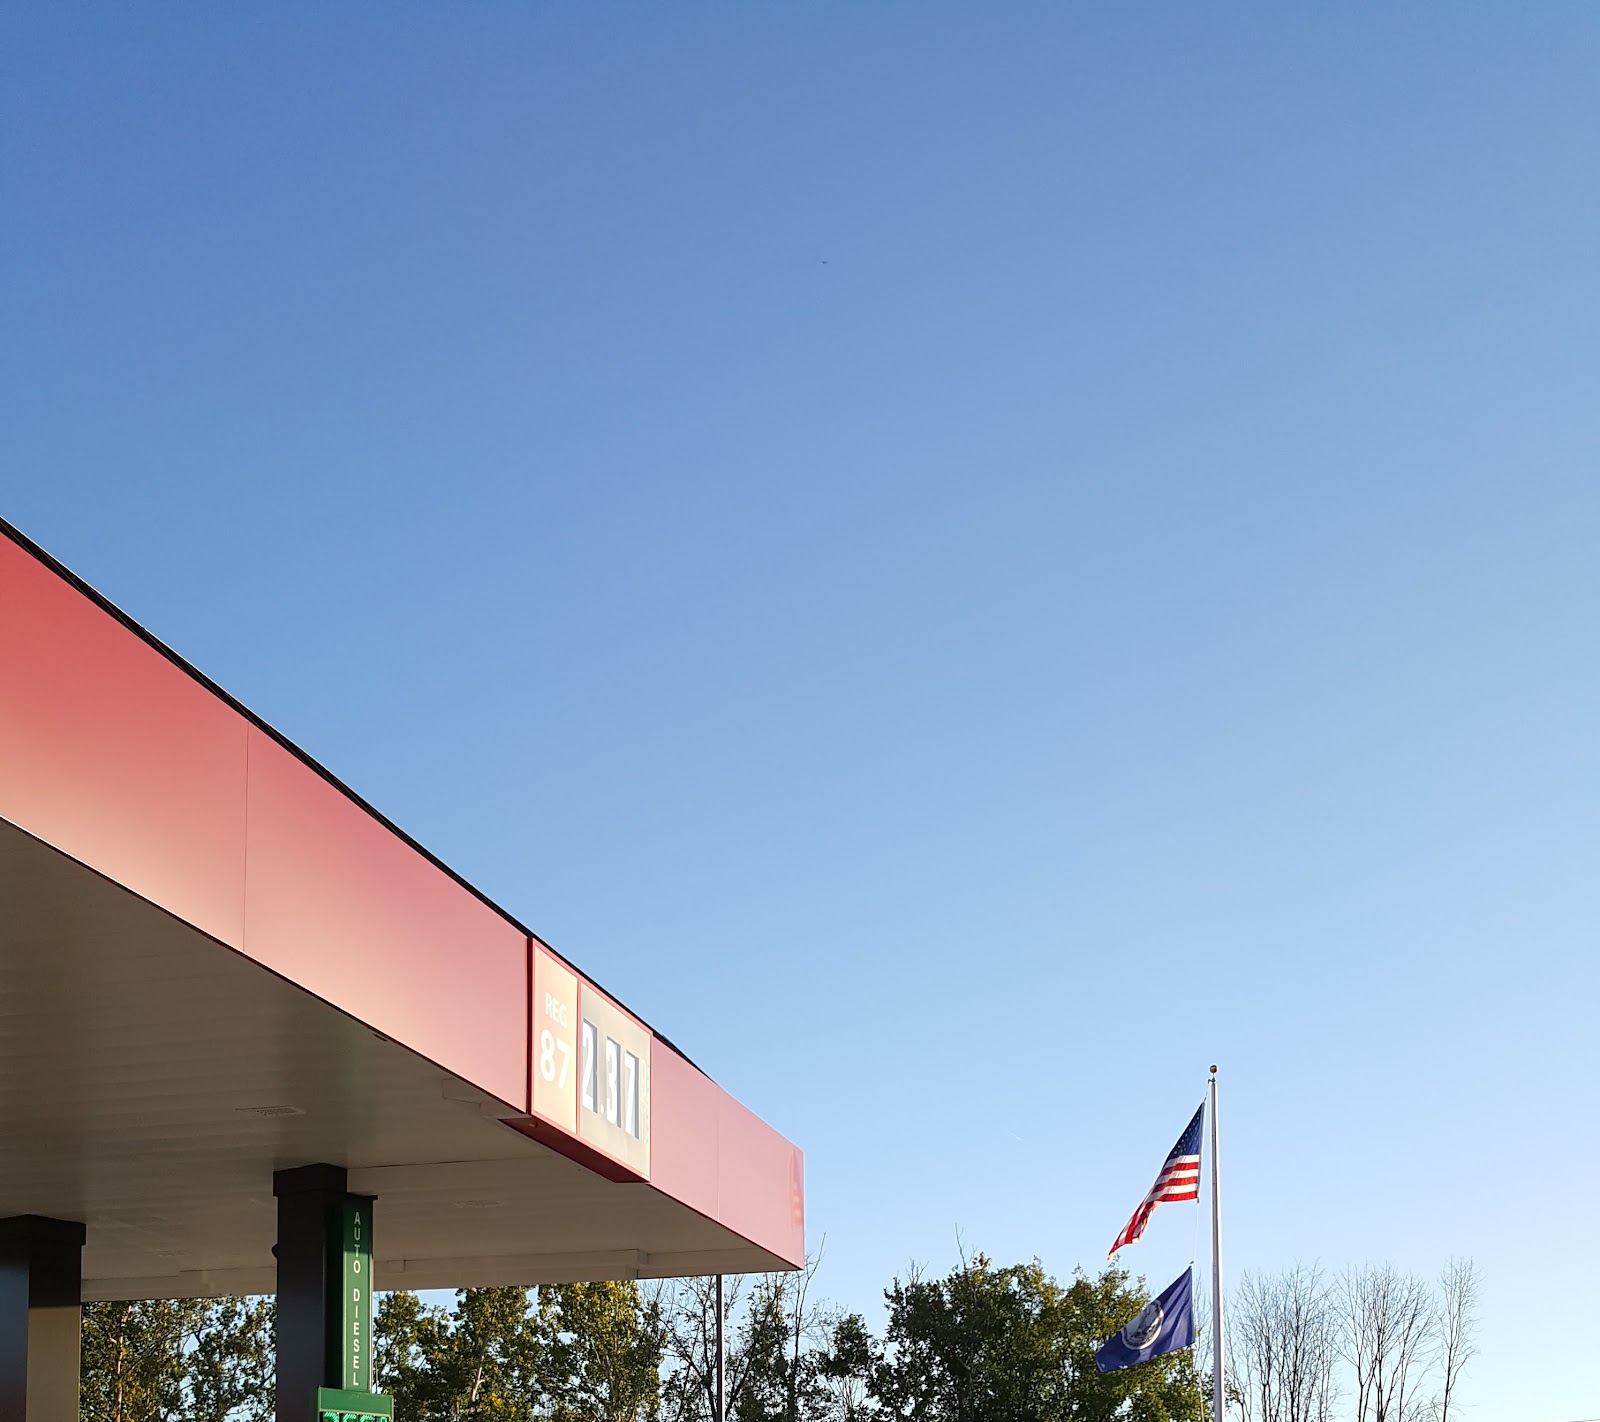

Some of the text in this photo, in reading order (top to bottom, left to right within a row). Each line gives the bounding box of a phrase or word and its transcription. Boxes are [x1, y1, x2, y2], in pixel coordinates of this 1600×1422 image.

[545, 992, 567, 1029] REG
[540, 1029, 570, 1089] 87
[353, 1211, 361, 1274] AUTO
